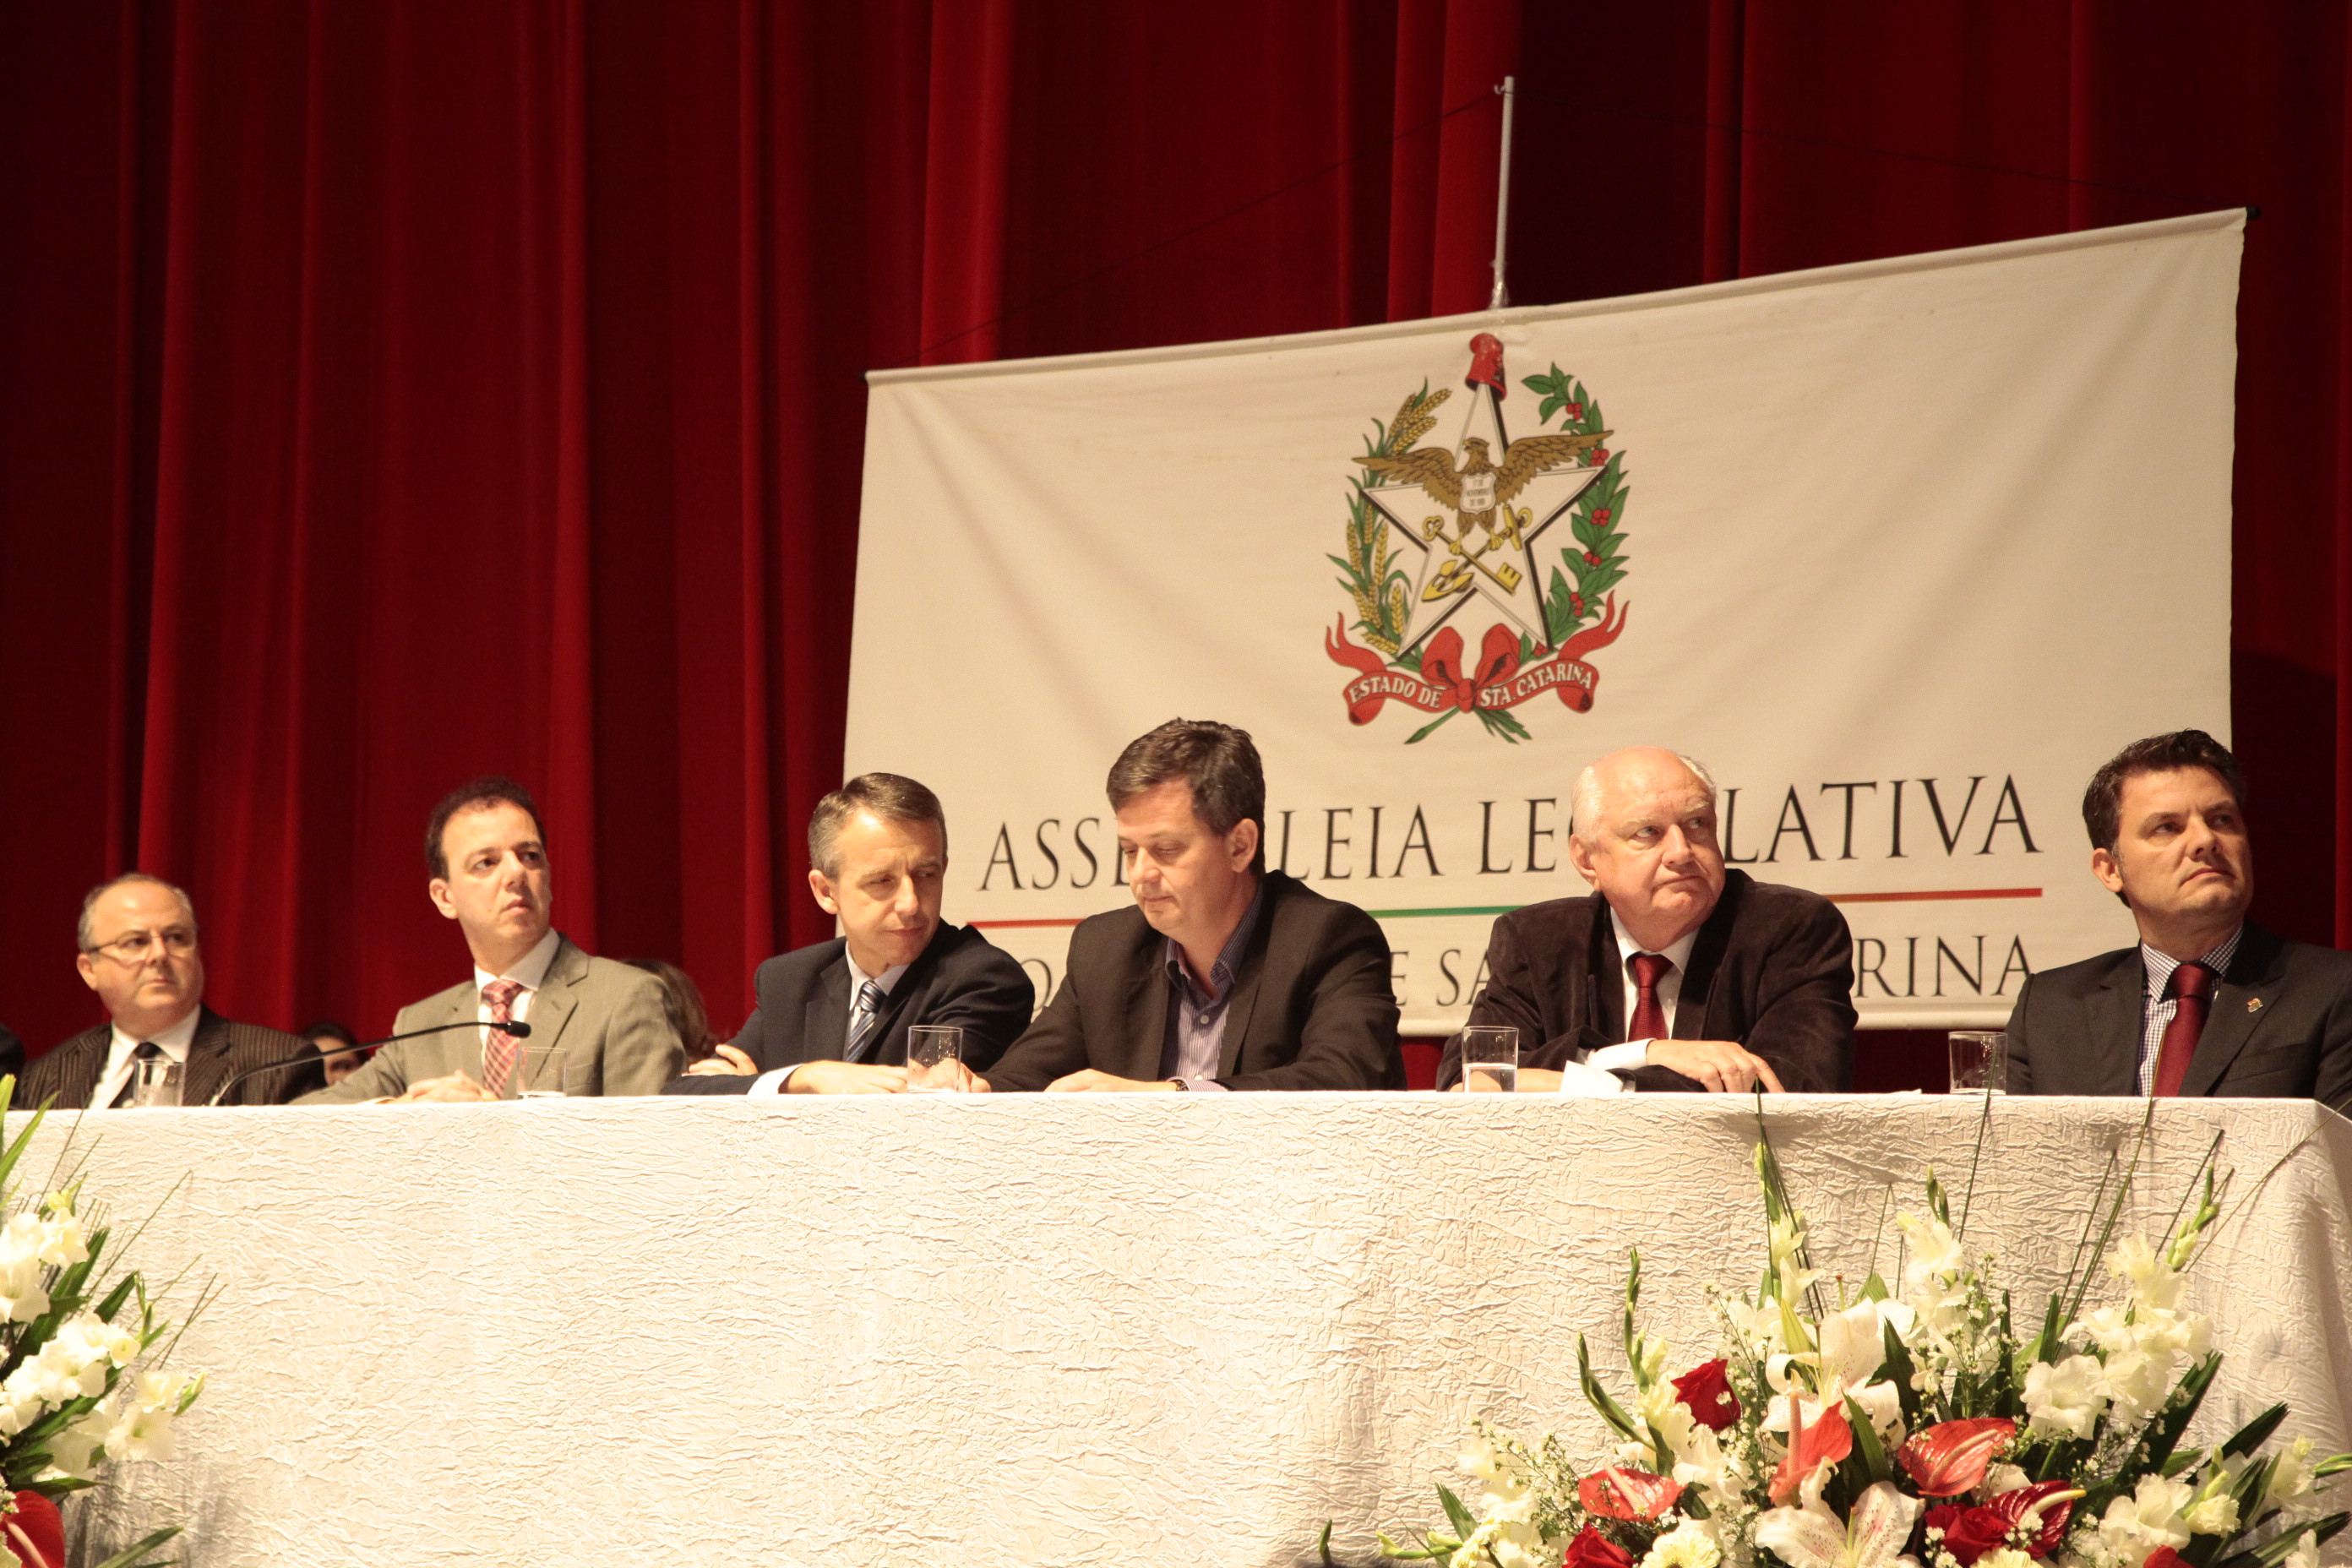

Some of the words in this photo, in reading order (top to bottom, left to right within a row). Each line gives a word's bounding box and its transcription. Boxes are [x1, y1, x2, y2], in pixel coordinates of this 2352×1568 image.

[1348, 676, 1417, 703] ESTADO
[1418, 687, 1442, 708] DE
[1480, 687, 1516, 706] STA.
[1516, 663, 1592, 697] CATARINA
[977, 804, 1445, 891] ASSLEIA
[1476, 774, 2044, 874] LELATIVA
